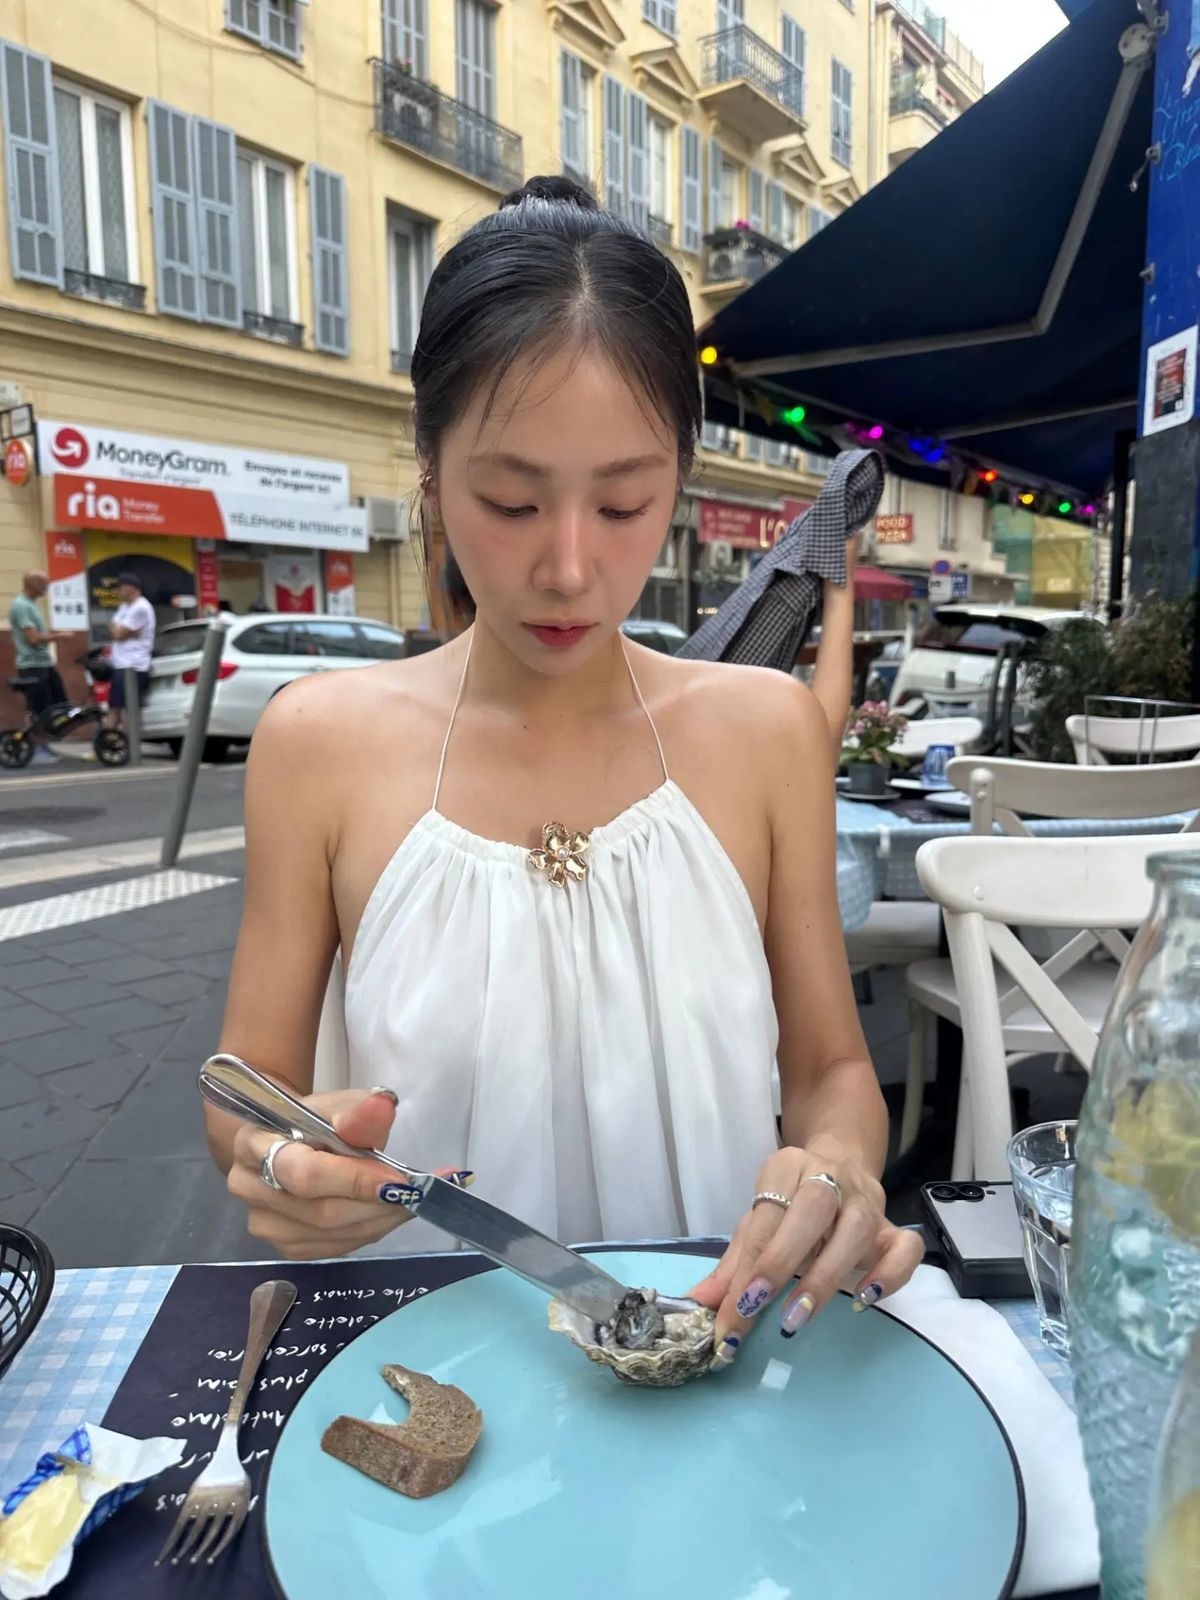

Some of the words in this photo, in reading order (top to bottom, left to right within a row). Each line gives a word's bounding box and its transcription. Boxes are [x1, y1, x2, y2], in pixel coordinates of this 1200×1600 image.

[7, 444, 27, 467] ria
[96, 440, 228, 476] MoneyGram
[67, 480, 121, 521] ria
[122, 497, 160, 512] Money
[299, 521, 349, 538] INTERNET
[313, 1288, 375, 1303] chinois
[207, 1343, 327, 1362] sorcelrie,
[198, 1378, 241, 1394] aim
[259, 1369, 309, 1391] plus
